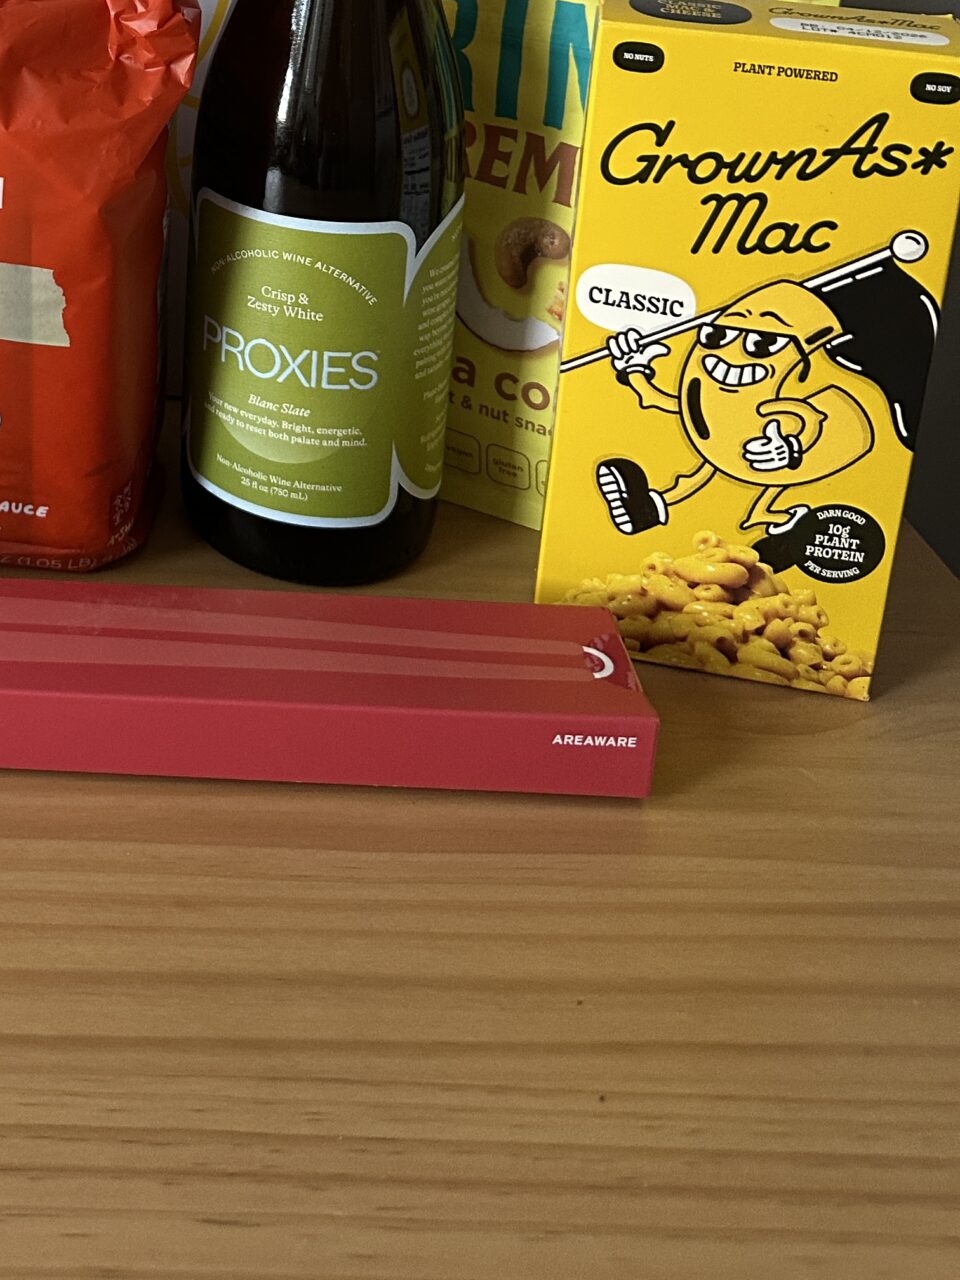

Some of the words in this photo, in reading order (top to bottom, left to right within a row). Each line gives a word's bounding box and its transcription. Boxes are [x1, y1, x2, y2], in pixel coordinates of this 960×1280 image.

[657, 0, 721, 9] CLASSIC
[660, 7, 721, 18] CHEESE
[665, 4, 704, 12] MAC
[623, 52, 633, 60] NO
[634, 54, 654, 62] NUTS
[733, 62, 775, 76] PLANT
[776, 66, 838, 82] POWERED
[925, 83, 936, 92] NO
[937, 85, 952, 93] SOY
[690, 192, 839, 255] Mac
[210, 249, 279, 273] NON-ALCOHOLIC
[282, 252, 312, 266] WINE
[314, 261, 378, 306] ALTERNATIVE
[261, 285, 295, 304] Crisp
[298, 293, 309, 305] &
[588, 286, 684, 318] CLASSIC
[247, 295, 280, 316] Zesty
[283, 306, 324, 322] White
[203, 315, 378, 390] PROXIES
[208, 391, 223, 406] Your
[224, 401, 239, 413] new
[240, 409, 279, 428] everyday.
[248, 394, 280, 411] Blanc
[281, 403, 311, 417] Slate
[461, 396, 472, 410] &
[479, 404, 509, 423] nut
[216, 409, 235, 425] ready
[236, 419, 245, 428] to
[246, 423, 267, 436] reset
[268, 429, 289, 441] both
[291, 435, 320, 446] palate
[322, 437, 340, 447] and
[342, 438, 367, 447] mind.
[216, 453, 268, 481] Non-Alcoholic
[269, 474, 291, 487] Wine
[293, 480, 342, 492] Alternative
[240, 476, 251, 487] 25
[251, 480, 258, 489] fl
[259, 485, 269, 493] oz
[270, 486, 289, 498] (750
[290, 491, 308, 501] mL)
[816, 509, 842, 520] DARN
[842, 510, 866, 525] GOOD
[828, 524, 851, 538] 10g
[814, 534, 860, 550] PLANT
[805, 545, 865, 563] PROTEIN
[804, 560, 821, 574] PER
[820, 566, 860, 578] SERVING
[552, 734, 637, 748] AREAWARE
